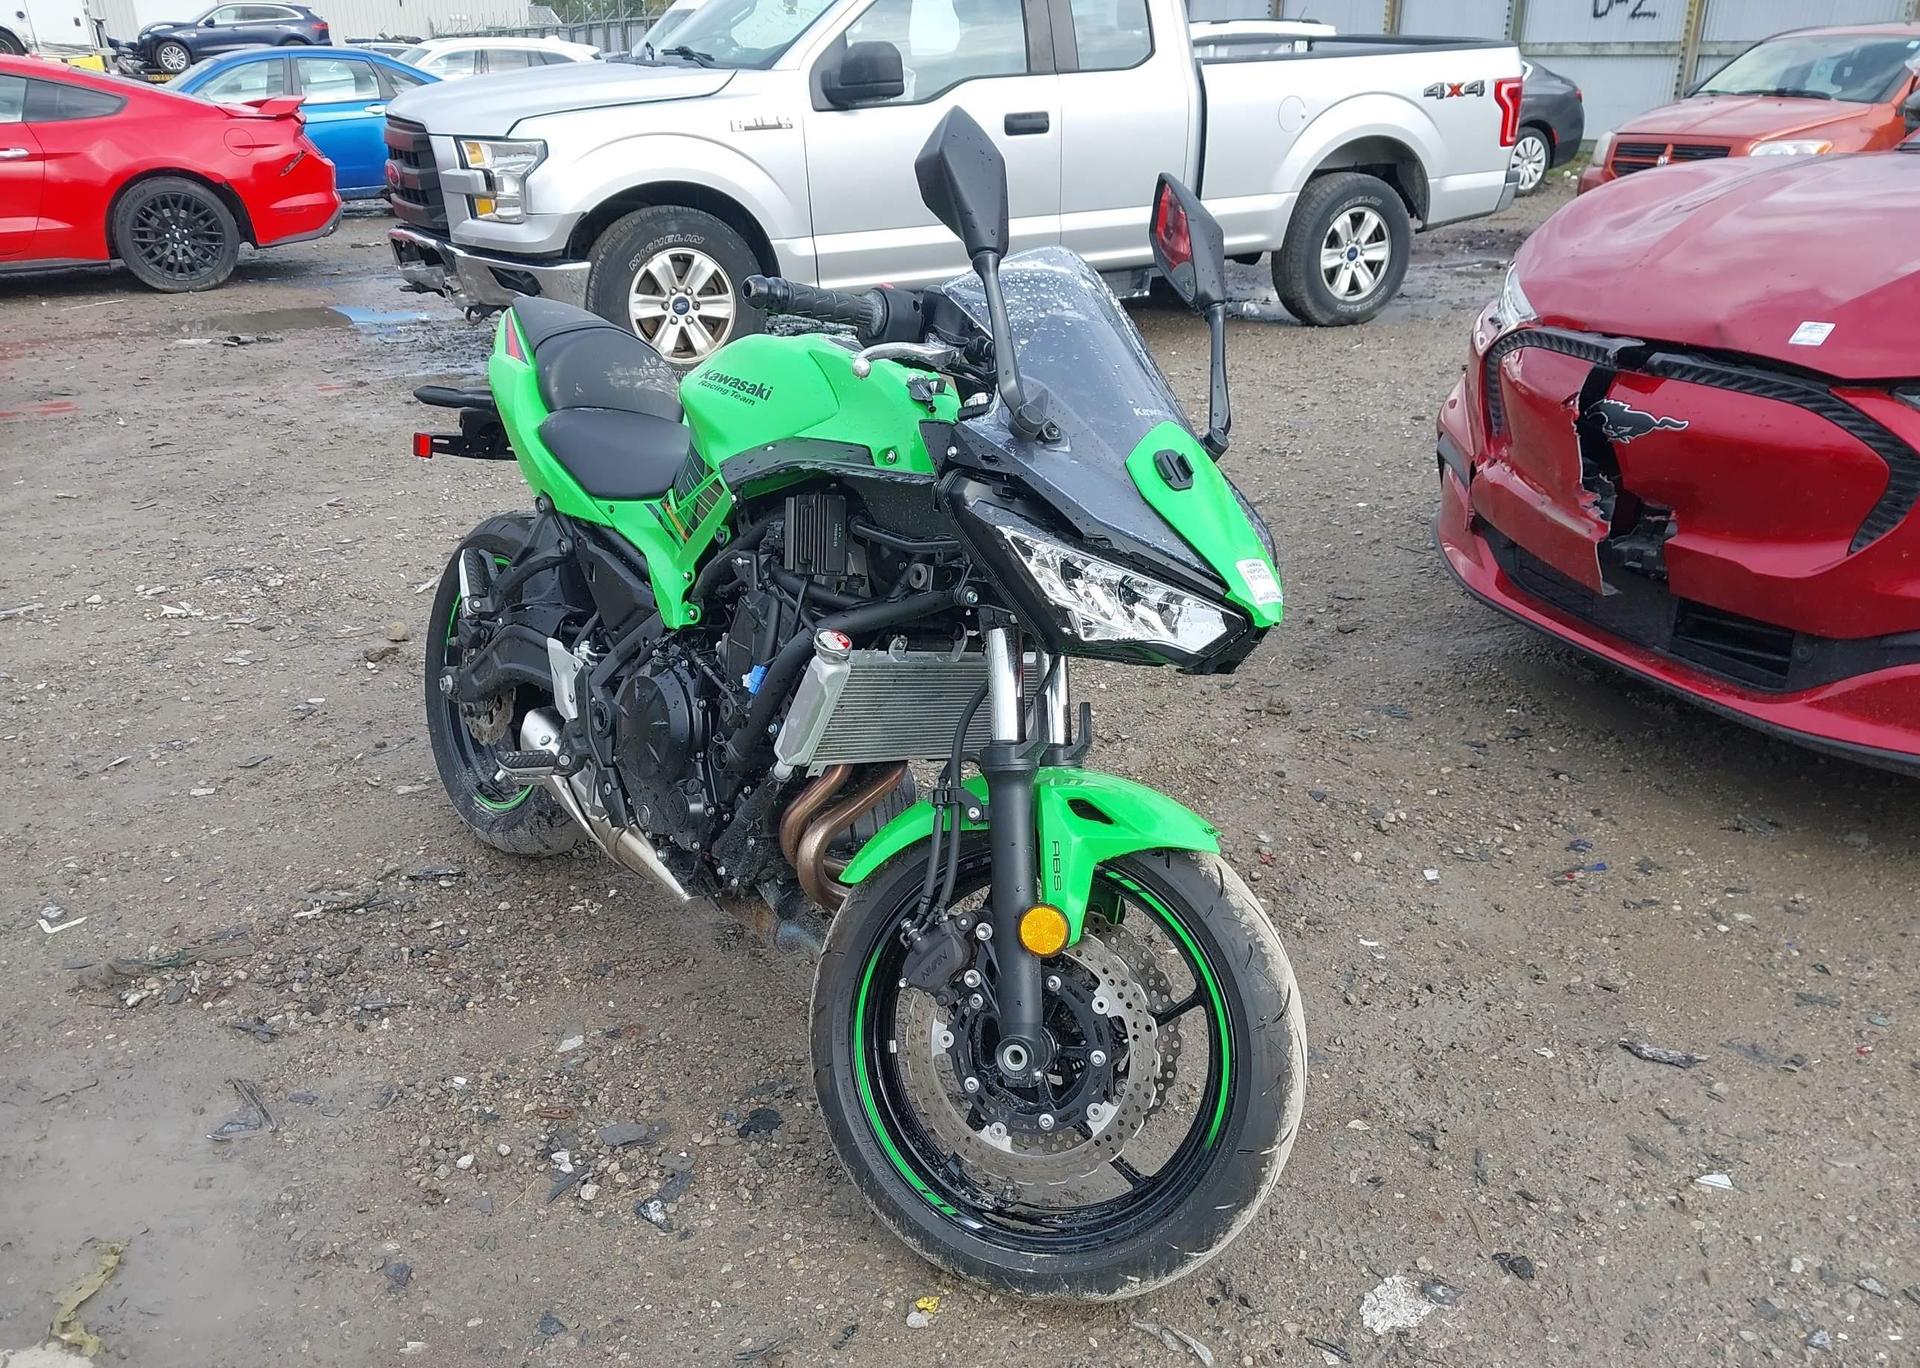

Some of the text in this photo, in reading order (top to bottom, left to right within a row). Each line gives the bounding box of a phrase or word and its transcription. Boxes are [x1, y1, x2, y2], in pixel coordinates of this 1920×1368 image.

[628, 233, 705, 271] MICHELIN
[698, 379, 756, 406] Racing Team
[699, 368, 774, 401] Kawasaki
[1052, 840, 1062, 891] ABS
